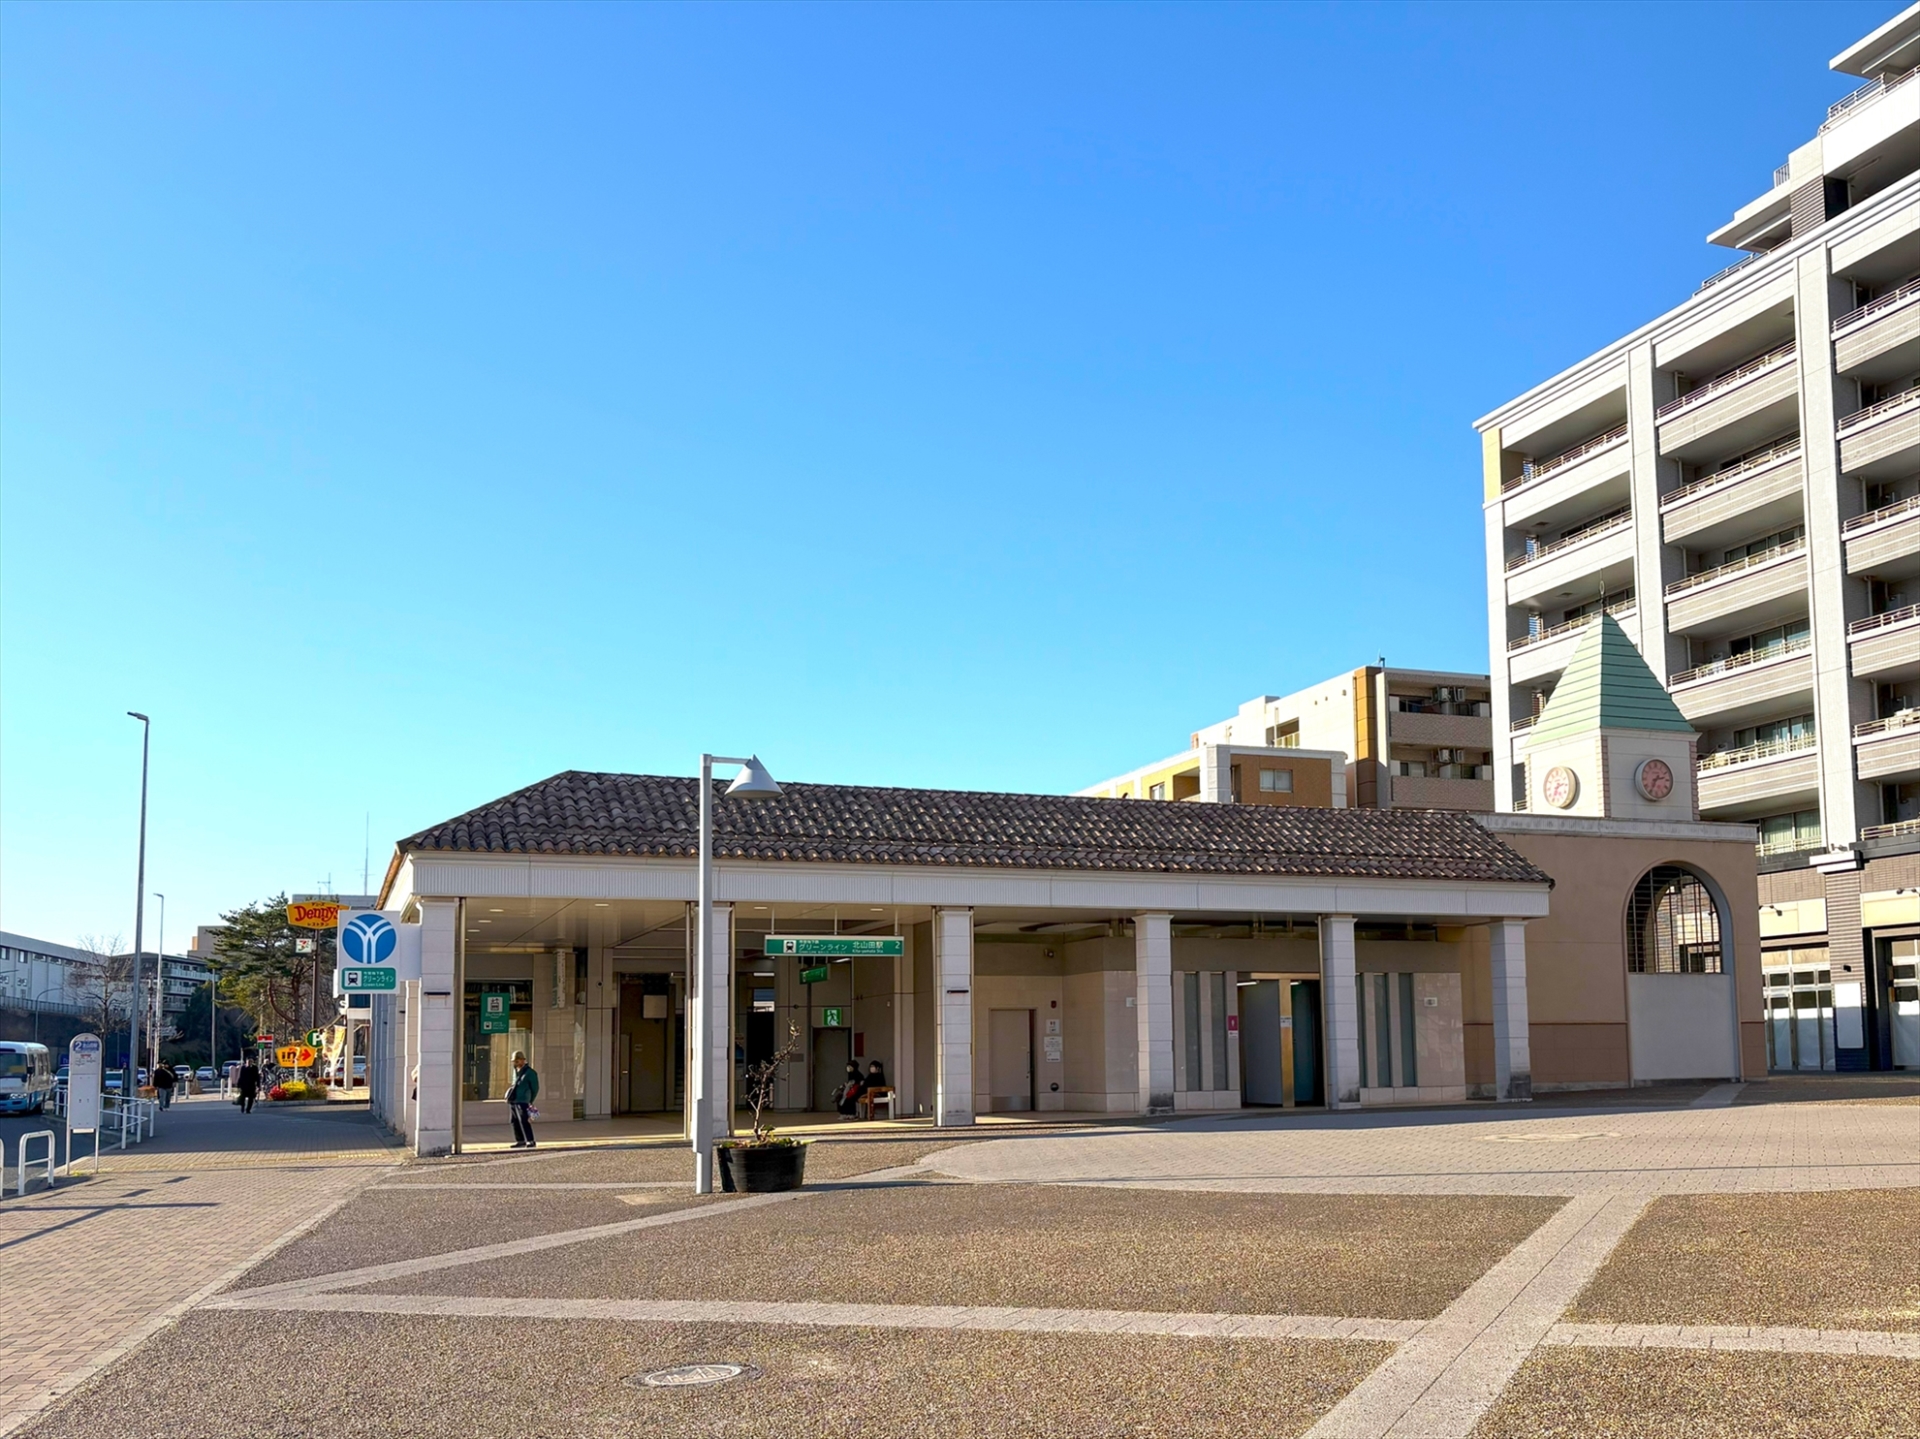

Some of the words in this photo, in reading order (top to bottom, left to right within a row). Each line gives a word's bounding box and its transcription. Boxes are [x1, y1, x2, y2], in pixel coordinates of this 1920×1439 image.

[799, 943, 847, 951] グリーンライン
[852, 941, 884, 949] 北山田駅
[895, 941, 901, 949] 2
[363, 975, 395, 983] グリーンライン
[75, 1041, 82, 1051] 2
